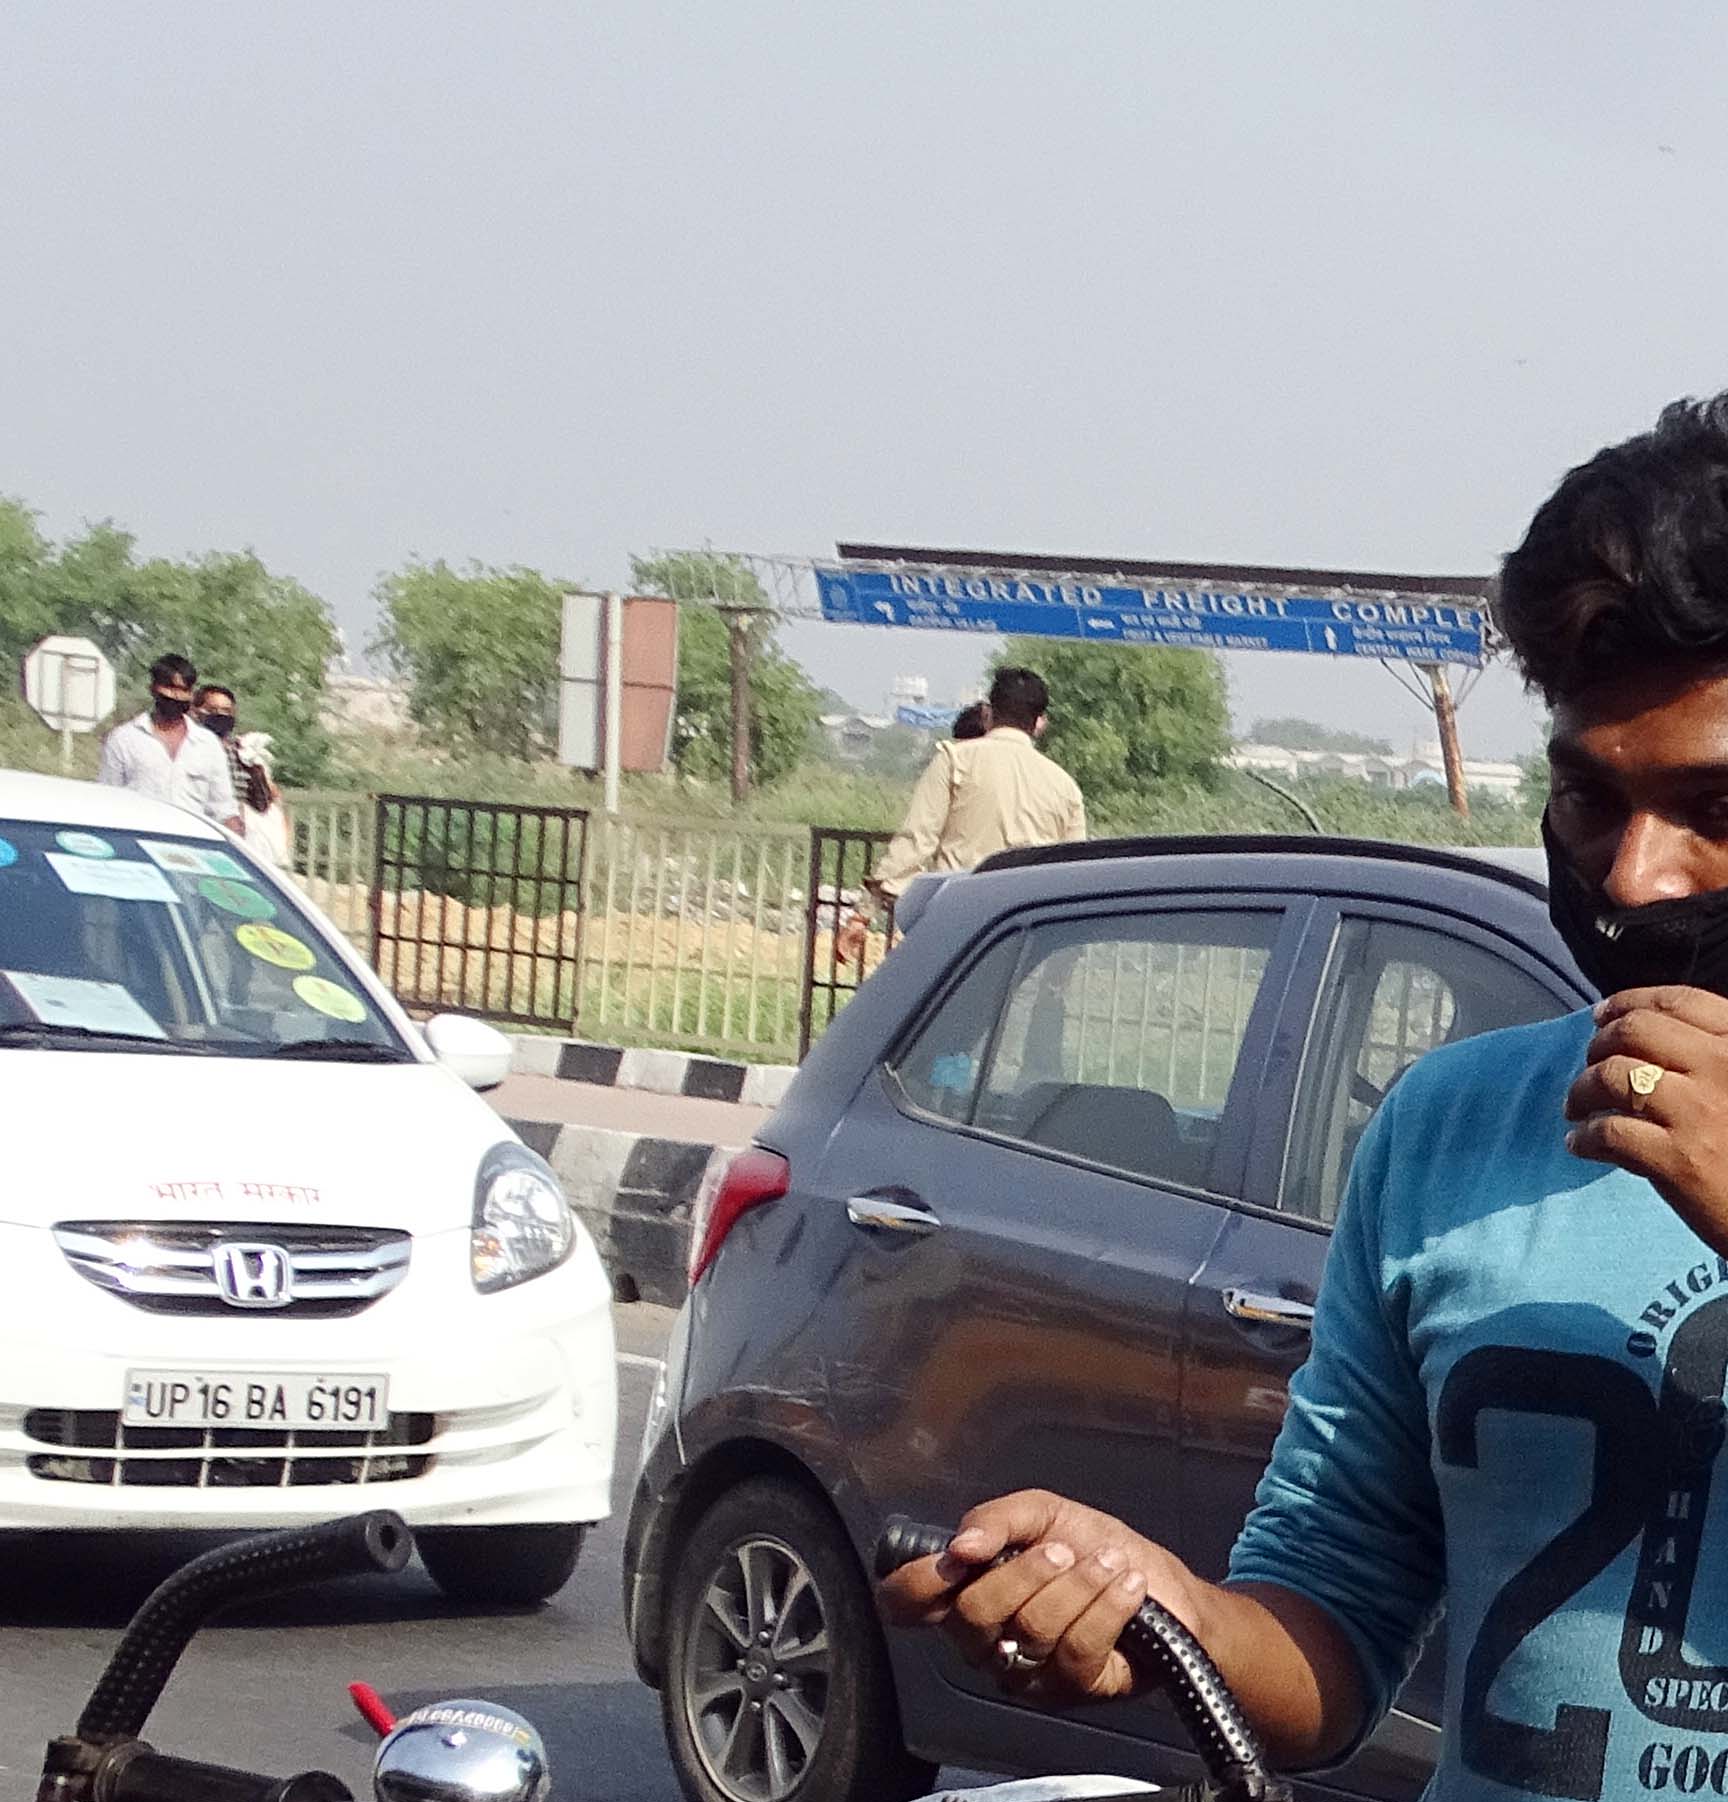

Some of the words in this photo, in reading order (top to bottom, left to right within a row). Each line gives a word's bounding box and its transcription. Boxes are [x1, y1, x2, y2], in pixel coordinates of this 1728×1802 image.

[888, 574, 1102, 608] INTEGRATED
[1142, 588, 1289, 617] FREIGHT
[150, 1181, 223, 1201] भारत
[238, 1182, 321, 1206] सरकार
[246, 1384, 288, 1421] BA
[306, 1386, 378, 1422] 6191
[1638, 1489, 1692, 1656] HAND
